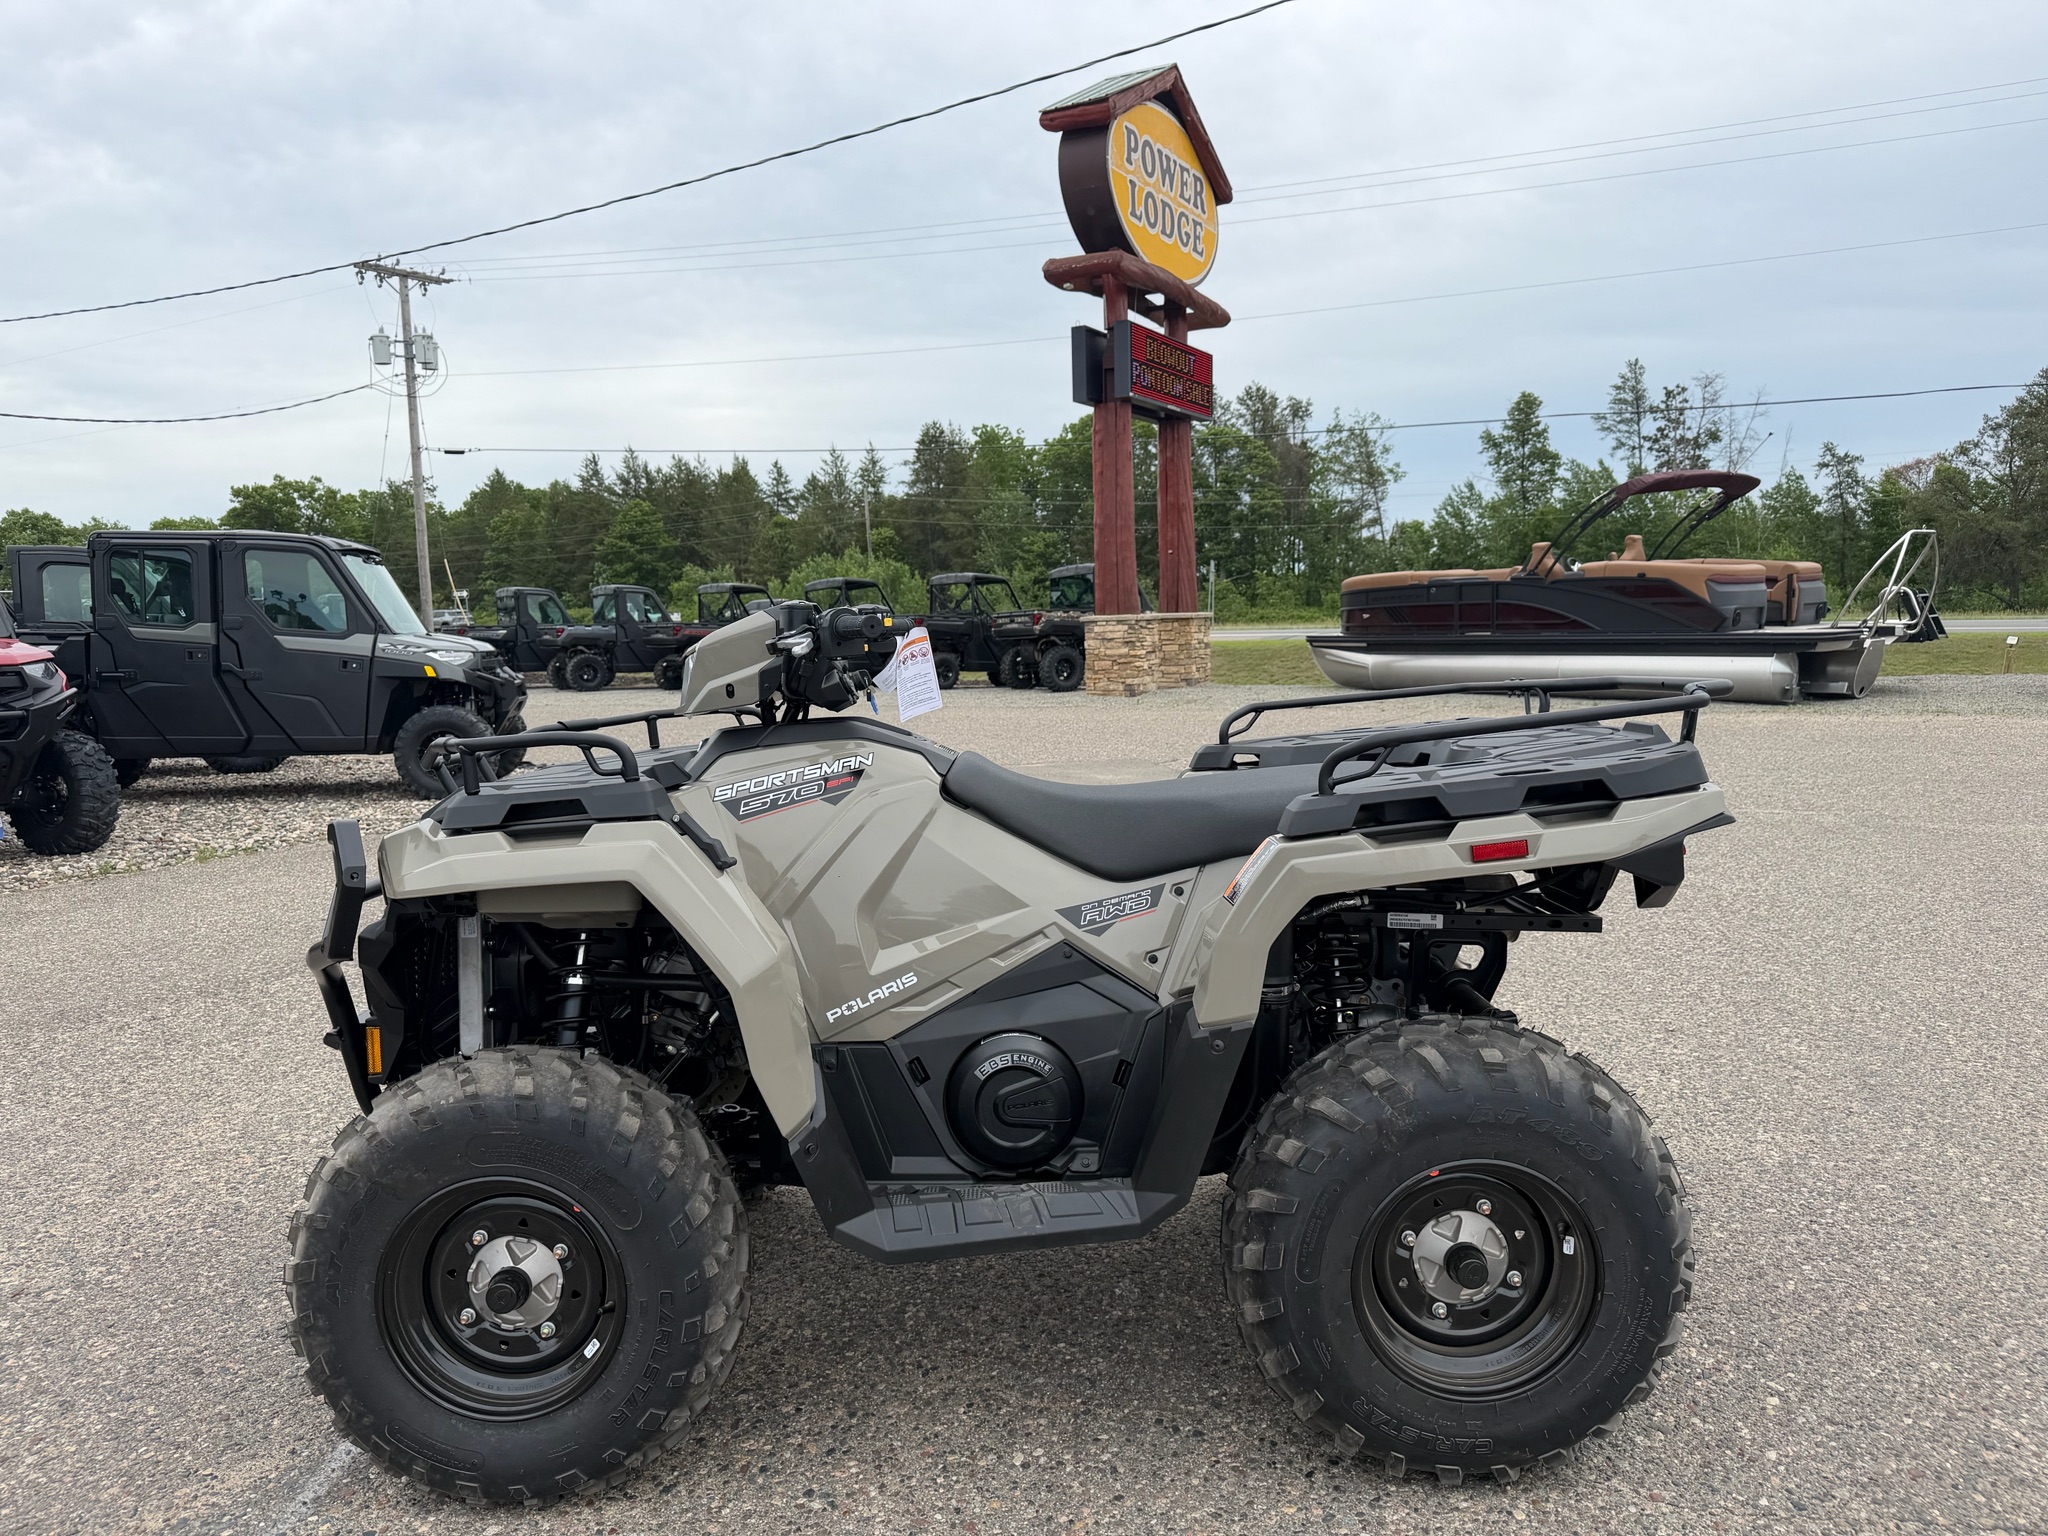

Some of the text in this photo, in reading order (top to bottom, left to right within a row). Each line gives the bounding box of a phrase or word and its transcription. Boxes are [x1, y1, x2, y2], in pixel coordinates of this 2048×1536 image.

[1124, 123, 1206, 216] POWER
[1128, 178, 1205, 259] LODGE
[1145, 337, 1196, 375] BLOWOUT
[1132, 361, 1210, 406] PONTOON SALE
[384, 648, 414, 656] 1000
[713, 752, 874, 801] SPORTSMAN
[739, 776, 854, 815] 570 EFI
[1081, 896, 1151, 925] AWD
[825, 971, 918, 1024] POLARIS
[978, 1054, 1052, 1077] EBS ENGINE
[607, 1289, 675, 1428] CARLSTAR
[1352, 1395, 1494, 1454] CARLSTAR
